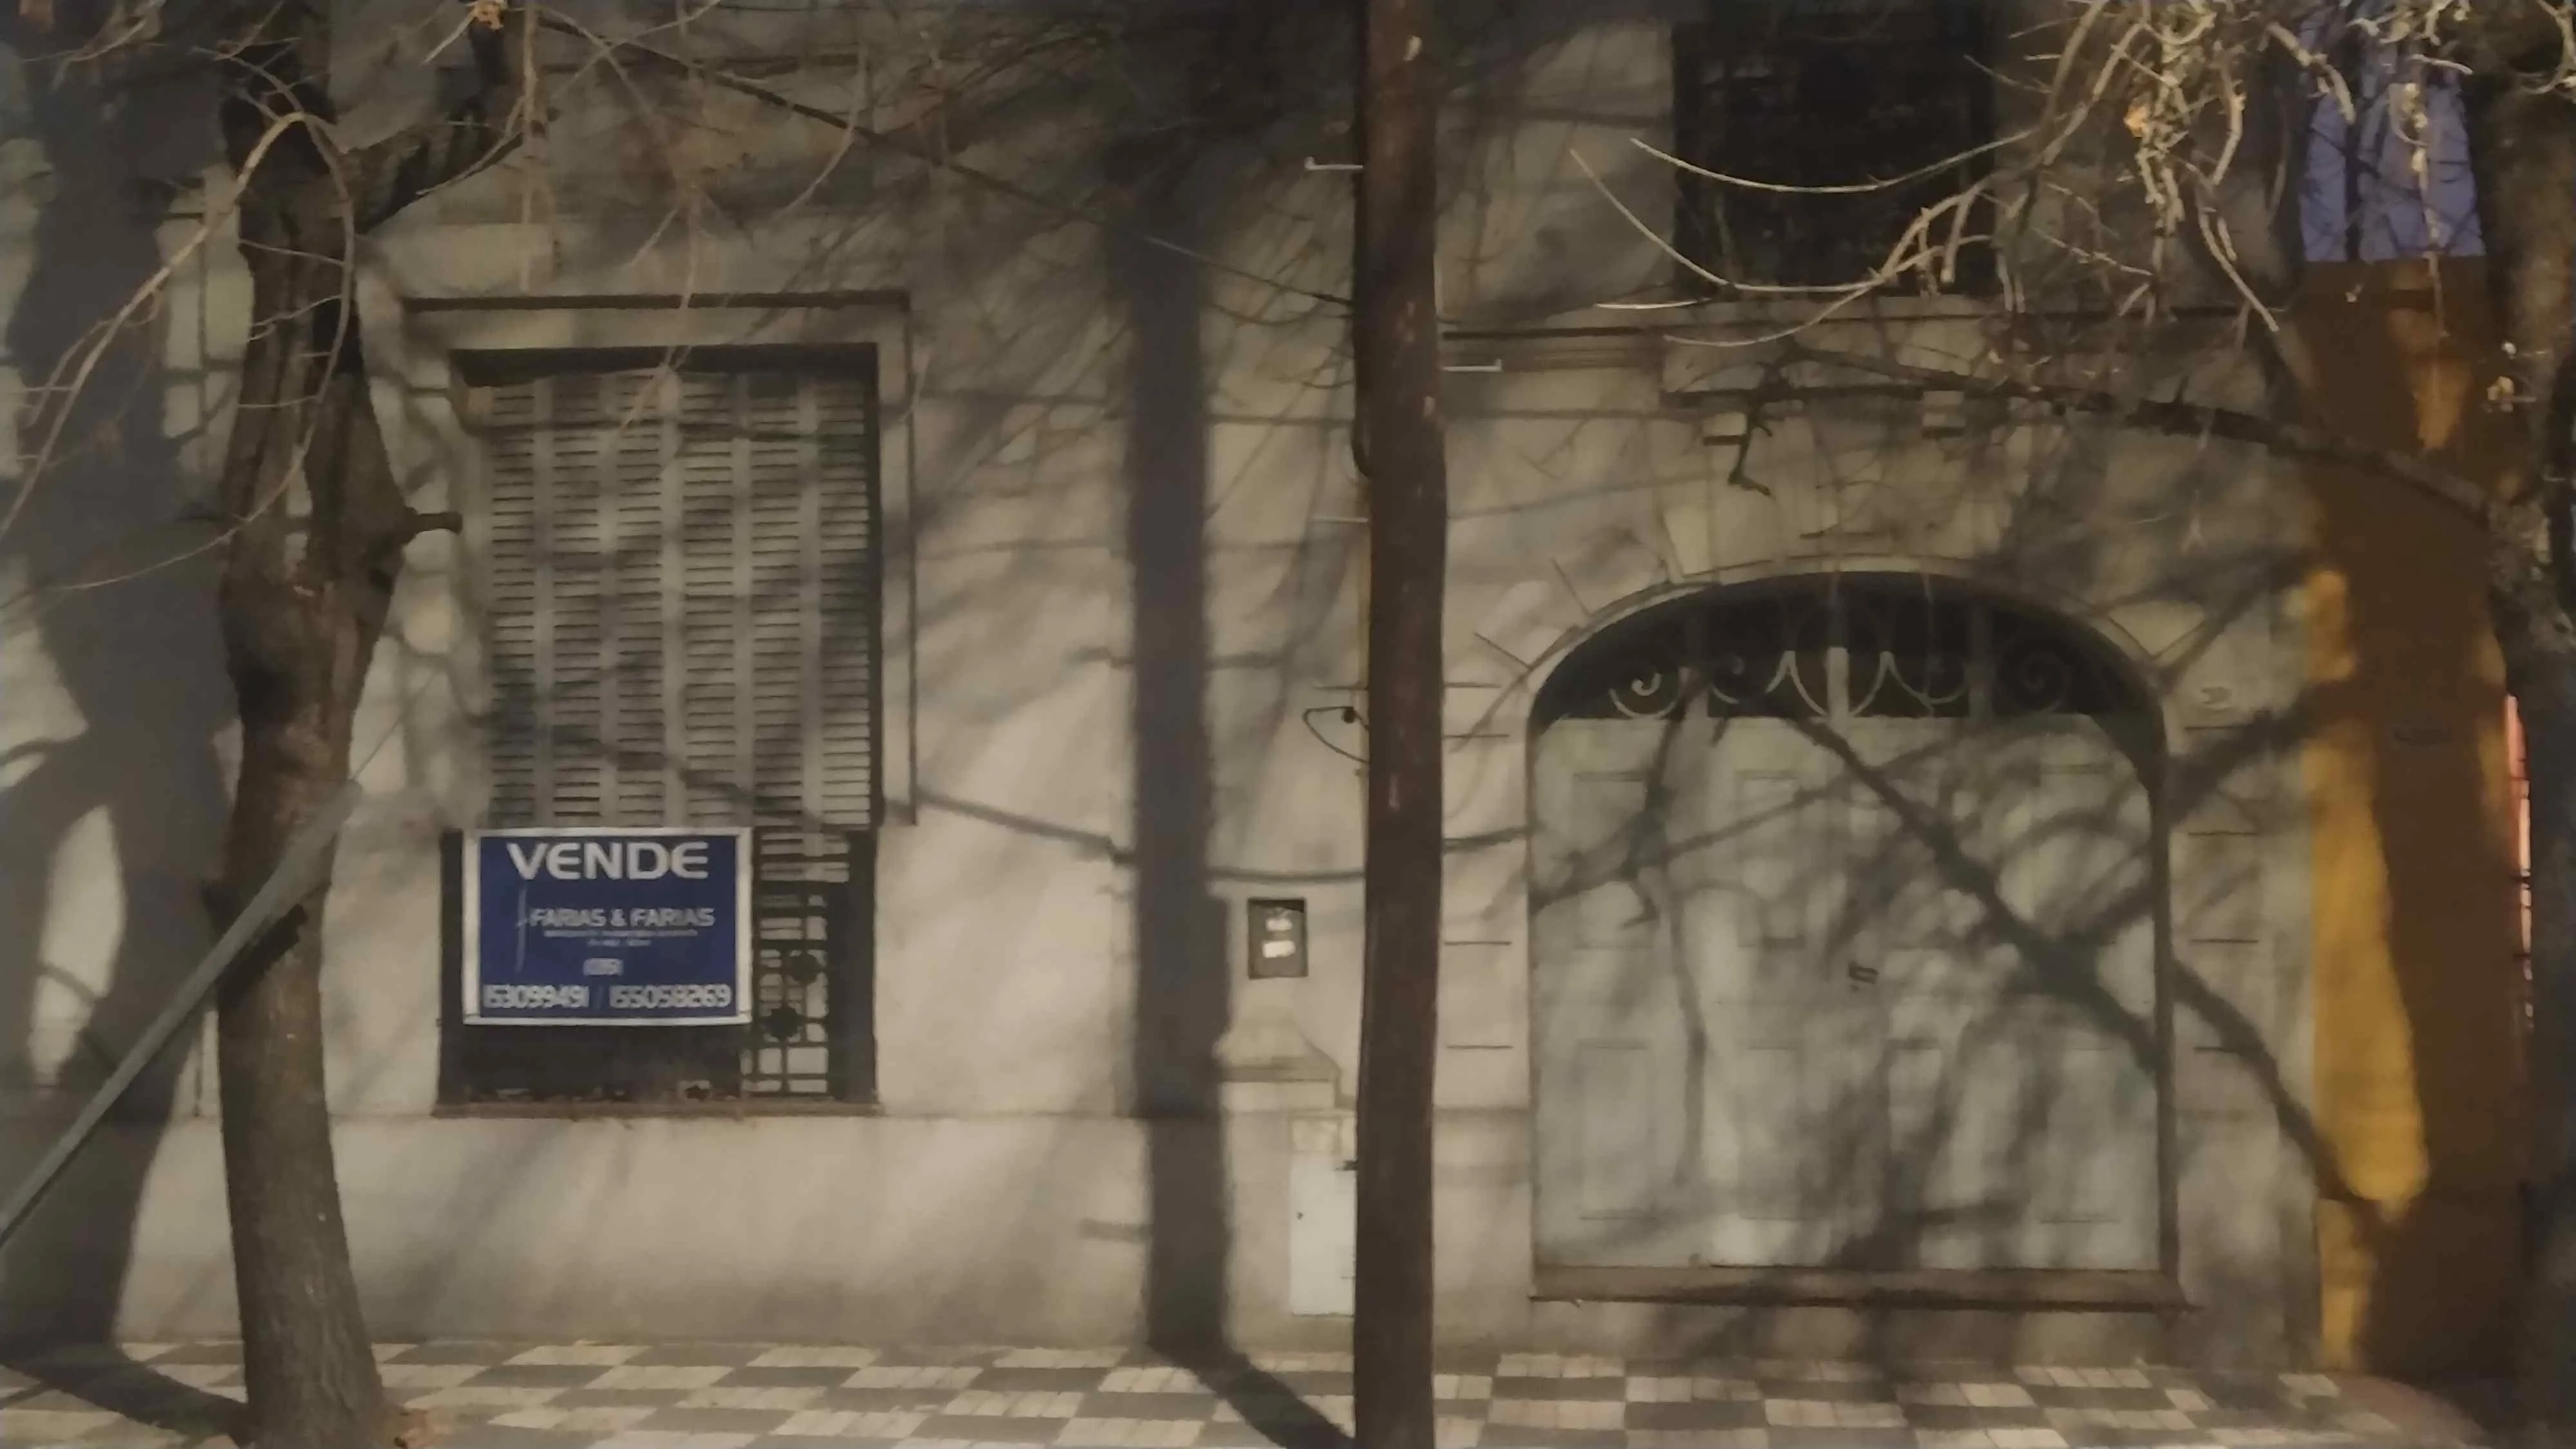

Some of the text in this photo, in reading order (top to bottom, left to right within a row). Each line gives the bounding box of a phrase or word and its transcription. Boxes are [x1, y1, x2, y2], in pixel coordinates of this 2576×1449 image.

[507, 842, 708, 879] VENDE
[529, 908, 715, 927] FARIAS & FARIAS
